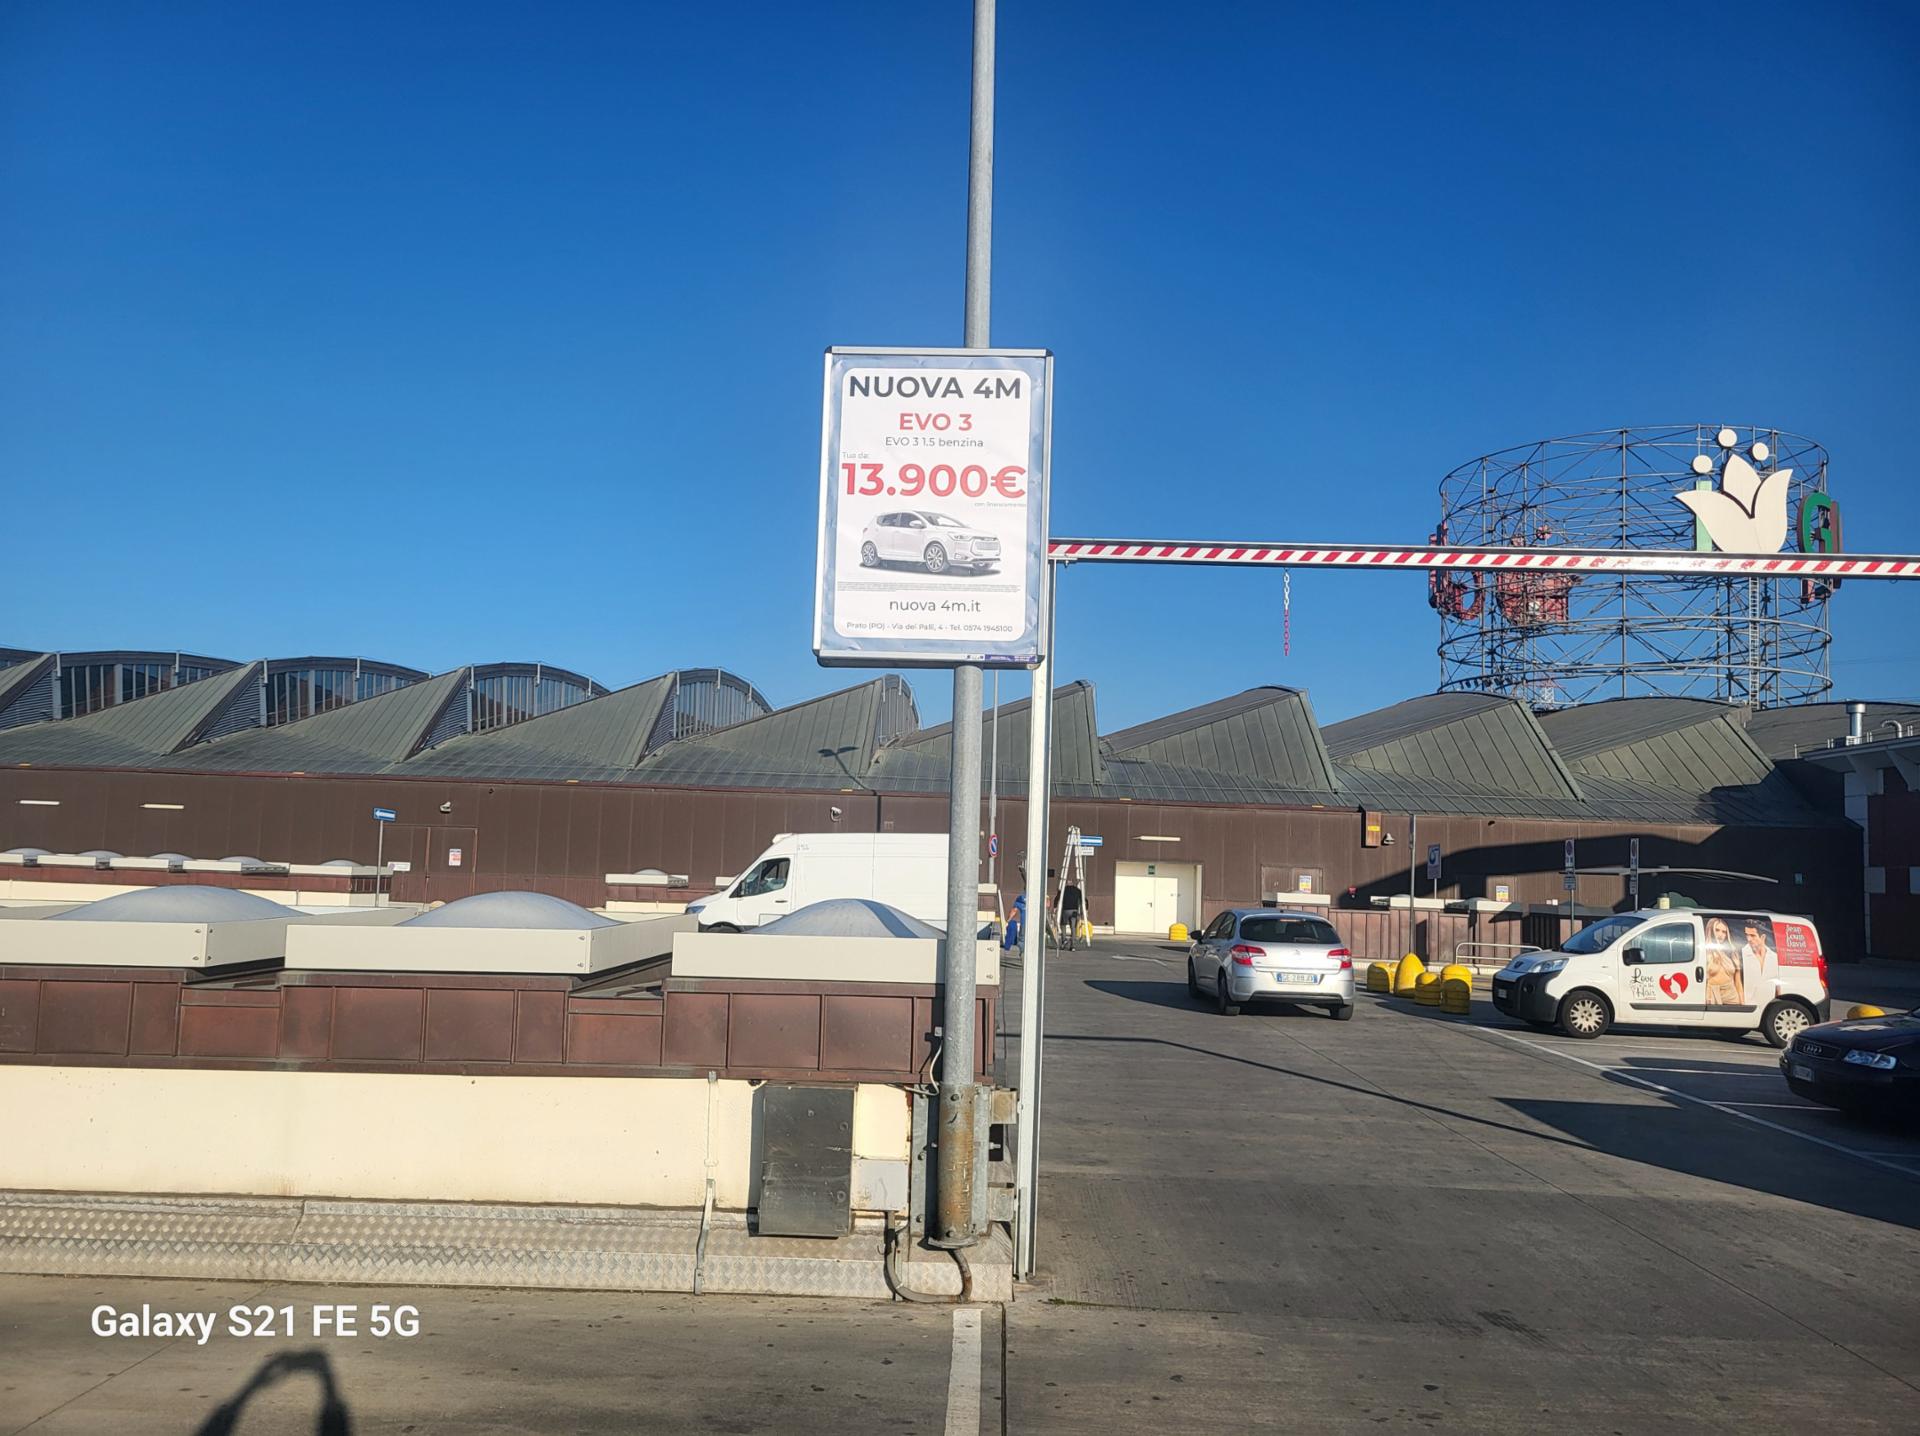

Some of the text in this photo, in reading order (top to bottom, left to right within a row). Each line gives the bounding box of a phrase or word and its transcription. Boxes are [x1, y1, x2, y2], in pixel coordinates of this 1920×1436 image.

[849, 376, 1021, 399] NUOVA 4M
[900, 413, 973, 431] EVO 3
[885, 436, 984, 448] EVO 3 1.5 benzina
[841, 462, 1027, 499] 13.900€
[889, 599, 982, 612] nuova 4m.it
[846, 622, 868, 630] Prato
[868, 622, 886, 631] (PO)
[891, 623, 904, 631] Via
[963, 624, 982, 632] 0574
[1631, 967, 1655, 984] Love
